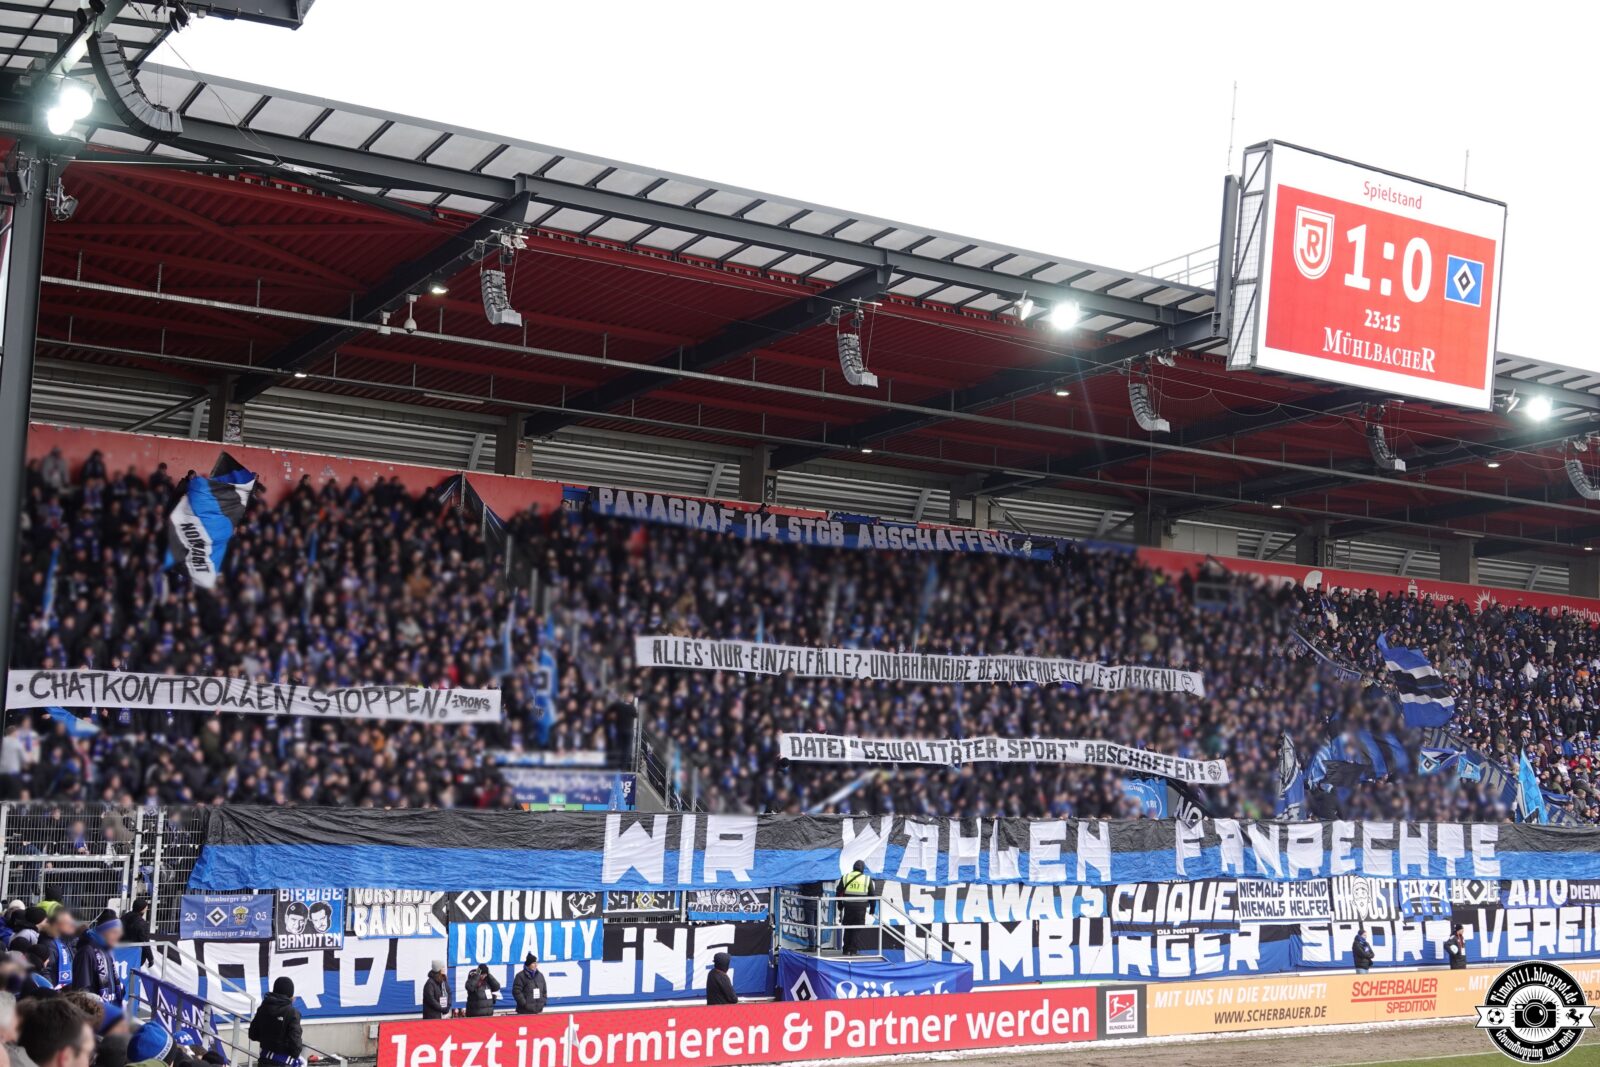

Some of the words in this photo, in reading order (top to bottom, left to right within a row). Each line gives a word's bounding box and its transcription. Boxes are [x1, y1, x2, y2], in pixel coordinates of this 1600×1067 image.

[1363, 181, 1422, 210] Spielstand
[1344, 223, 1432, 303] 1:0
[1364, 309, 1400, 333] 23:15
[1323, 326, 1435, 373] MÜHLBACHER
[598, 488, 732, 532] PARAGRAF
[744, 512, 778, 541] 114
[788, 516, 844, 546] STGB
[653, 639, 703, 666] ALLES
[711, 642, 743, 669] NUR
[28, 671, 295, 709] CHATKONTROLLEN
[314, 686, 450, 718] STOPPEN!
[790, 736, 846, 759] DATEI
[601, 814, 758, 885] WIR
[1239, 880, 1284, 898] NIEMALS
[1289, 879, 1327, 897] FREUND
[185, 912, 197, 922] 20
[490, 889, 564, 921] IRON
[1111, 881, 1237, 928] CLIQUE
[1240, 899, 1286, 918] NIEMALS
[1290, 899, 1329, 916] HELFER
[354, 904, 433, 937] BANDE
[278, 933, 342, 949] BANDITEN
[456, 919, 598, 965] LOYALTY
[1155, 990, 1182, 1009] MIT
[1185, 988, 1213, 1007] UNS
[1217, 987, 1233, 1005] IN
[1236, 985, 1260, 1004] DIE
[1264, 983, 1327, 1002] ZUKUNFT!
[1351, 977, 1438, 997] SCHERBAUER
[1214, 1005, 1327, 1025] WWW.SCHERBAUER.DE
[1386, 999, 1436, 1015] SPEDITION
[515, 1017, 769, 1067] informieren
[782, 1012, 812, 1051] &
[824, 1009, 957, 1050] Partner
[966, 999, 1090, 1040] werden
